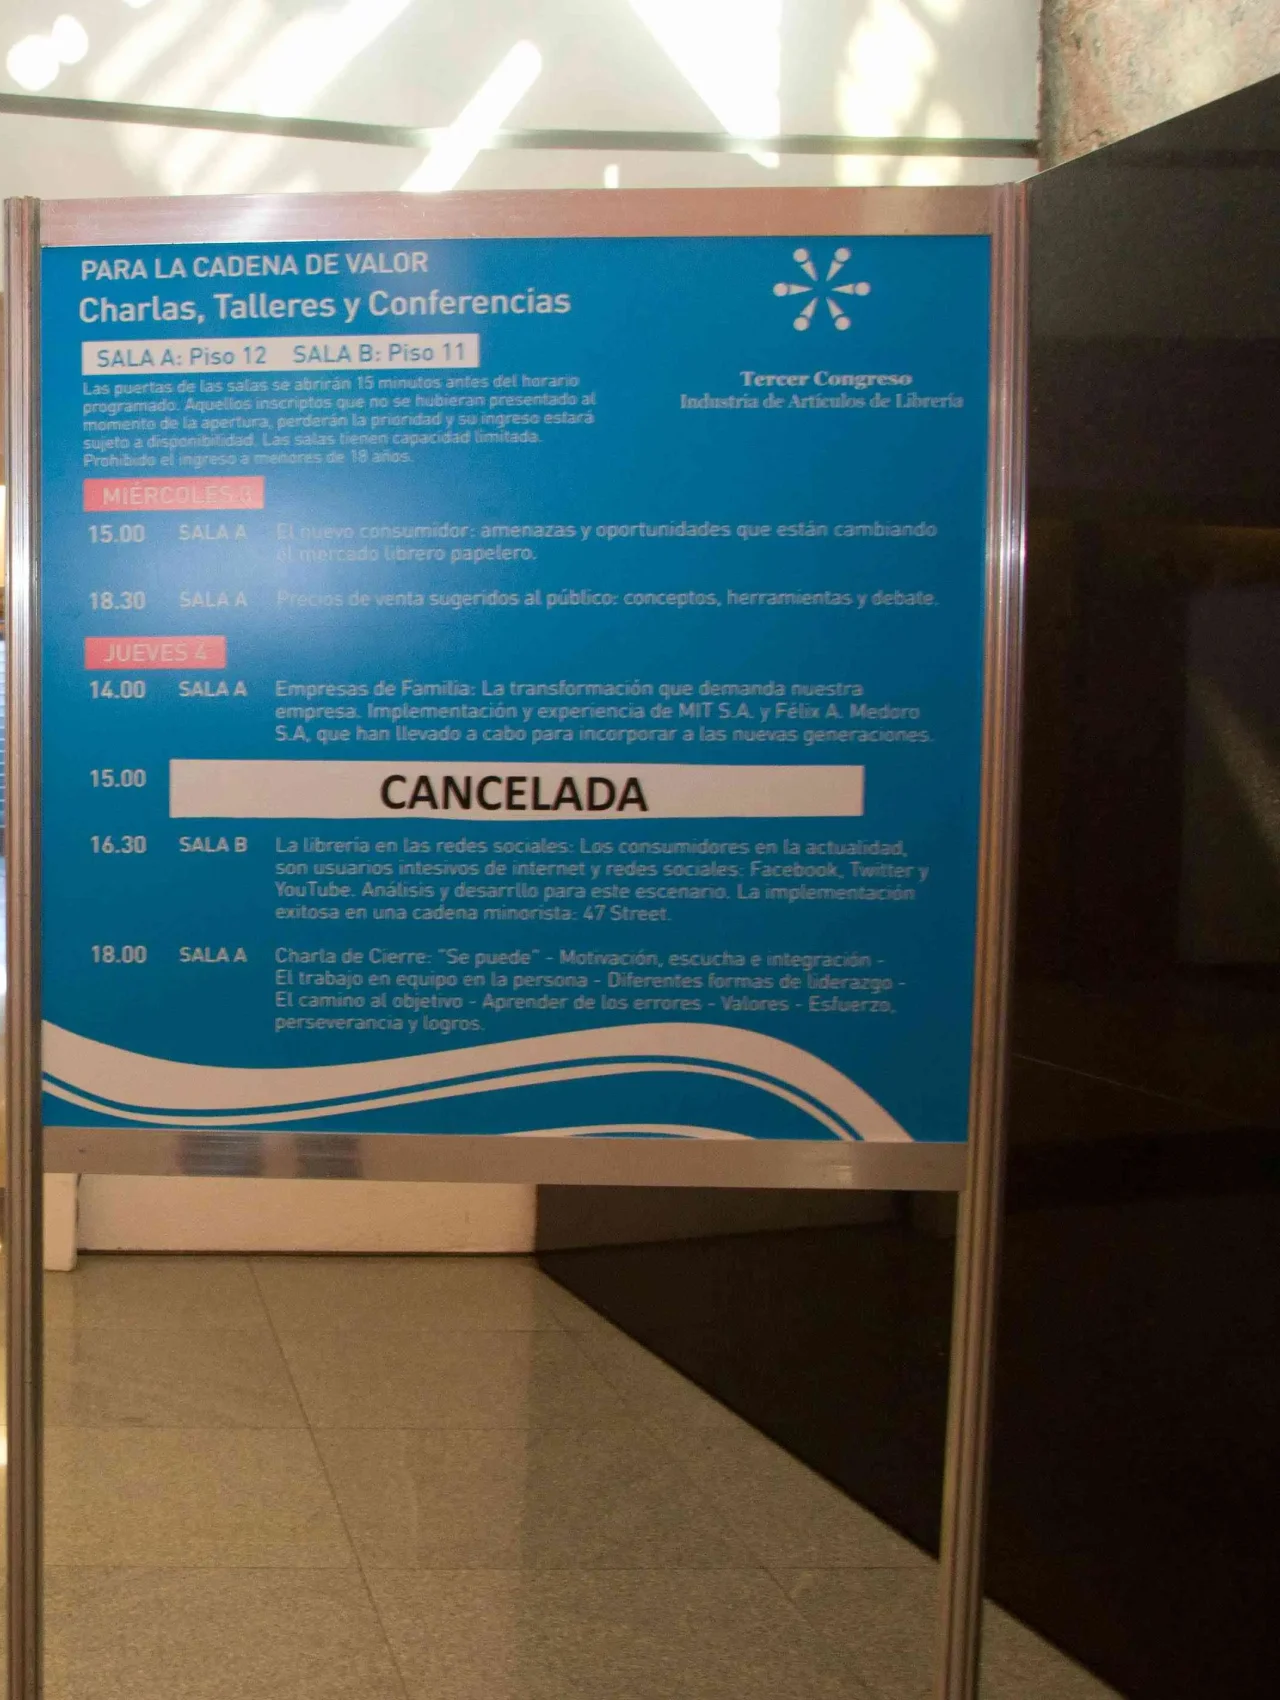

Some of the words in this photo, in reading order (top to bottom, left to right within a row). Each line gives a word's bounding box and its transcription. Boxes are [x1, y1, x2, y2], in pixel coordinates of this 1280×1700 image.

[81, 257, 148, 281] PARA
[154, 256, 187, 279] LA
[192, 253, 299, 278] CADENA
[305, 252, 339, 275] DE
[345, 250, 427, 274] VALOR
[78, 294, 206, 326] Charlas,
[214, 291, 336, 319] Talleres
[344, 297, 360, 323] y
[368, 286, 572, 316] Conferencias
[97, 347, 154, 367] SALA
[159, 347, 182, 366] A:
[189, 346, 236, 366] Piso
[243, 345, 266, 365] 12
[293, 343, 352, 364] SALA
[358, 343, 380, 362] B:
[388, 341, 434, 361] Piso
[444, 341, 464, 360] 11
[82, 380, 111, 395] Las
[113, 380, 174, 397] puertas
[227, 377, 268, 392] salas
[378, 374, 442, 390] minutos
[445, 374, 489, 388] antes
[521, 372, 580, 387] horario
[740, 370, 810, 386] Tercer
[814, 370, 914, 389] Congreso
[680, 393, 759, 408] Industria
[89, 524, 145, 543] 15.00
[178, 523, 230, 540] SALA
[234, 523, 248, 539] A
[90, 590, 146, 610] 18.30
[178, 590, 230, 607] SALA
[234, 590, 248, 606] A
[103, 642, 188, 663] JUEVES
[195, 641, 208, 660] 4
[89, 679, 146, 698] 14.00
[178, 680, 230, 697] SALA
[234, 680, 248, 697] A
[276, 679, 369, 700] Empresas
[400, 679, 475, 696] Familia:
[481, 679, 505, 696] La
[509, 678, 653, 696] transformación
[698, 679, 786, 696] demanda
[791, 680, 864, 696] nuestra
[274, 706, 360, 722] empresa.
[367, 701, 518, 722] Implementación
[537, 702, 645, 722] experiencia
[678, 702, 712, 718] MIT
[717, 702, 754, 718] S.A.
[775, 701, 820, 718] Félix
[849, 702, 920, 719] Medoro
[395, 724, 462, 741] llevado
[482, 724, 527, 741] cabo
[531, 728, 574, 745] para
[579, 724, 676, 745] incorporar
[732, 729, 798, 741] nuevas
[803, 725, 934, 745] generaciones.
[90, 768, 146, 787] 15.00
[380, 774, 649, 812] CANCELADA
[90, 835, 147, 853] 16.30
[178, 836, 230, 852] SALA
[234, 836, 248, 852] B
[275, 836, 298, 852] La
[303, 835, 370, 853] librería
[436, 837, 488, 853] redes
[492, 837, 573, 853] sociales:
[579, 837, 614, 854] Los
[618, 837, 750, 854] consumidores
[805, 838, 908, 857] actualidad,
[313, 858, 393, 875] usuarios
[398, 858, 480, 875] intesivos
[512, 859, 585, 876] internet
[605, 859, 658, 876] redes
[662, 860, 743, 877] sociales:
[749, 860, 846, 879] Facebook,
[849, 861, 914, 877] Twitter
[274, 880, 354, 897] YouTube.
[361, 880, 435, 897] Análisis
[543, 886, 586, 902] para
[590, 883, 630, 898] este
[634, 882, 730, 899] escenario.
[736, 883, 760, 899] La
[765, 882, 915, 904] implementación
[275, 903, 341, 919] exitosa
[412, 903, 479, 920] cadena
[482, 904, 576, 920] minorista:
[583, 904, 605, 920] 47
[609, 904, 672, 921] Street.
[91, 944, 147, 963] 18.00
[178, 946, 230, 962] SALA
[234, 946, 248, 962] A
[275, 947, 337, 963] Charla
[368, 947, 431, 964] Cierre:
[668, 949, 746, 966] escucha
[766, 949, 871, 971] integración
[275, 969, 292, 985] El
[298, 969, 364, 989] trabajo
[395, 969, 458, 990] equipo
[513, 974, 588, 991] persona
[607, 971, 703, 988] Diferentes
[707, 972, 774, 989] formas
[807, 972, 893, 993] liderazgo
[275, 991, 293, 1007] El
[298, 991, 365, 1008] camino
[392, 992, 463, 1012] objetivo
[482, 992, 567, 1013] Aprender
[632, 997, 702, 1010] errores
[720, 994, 789, 1011] Valores
[807, 995, 898, 1014] Esfuerzo,
[274, 1013, 404, 1033] perseverancia
[422, 1014, 486, 1034] logros.
